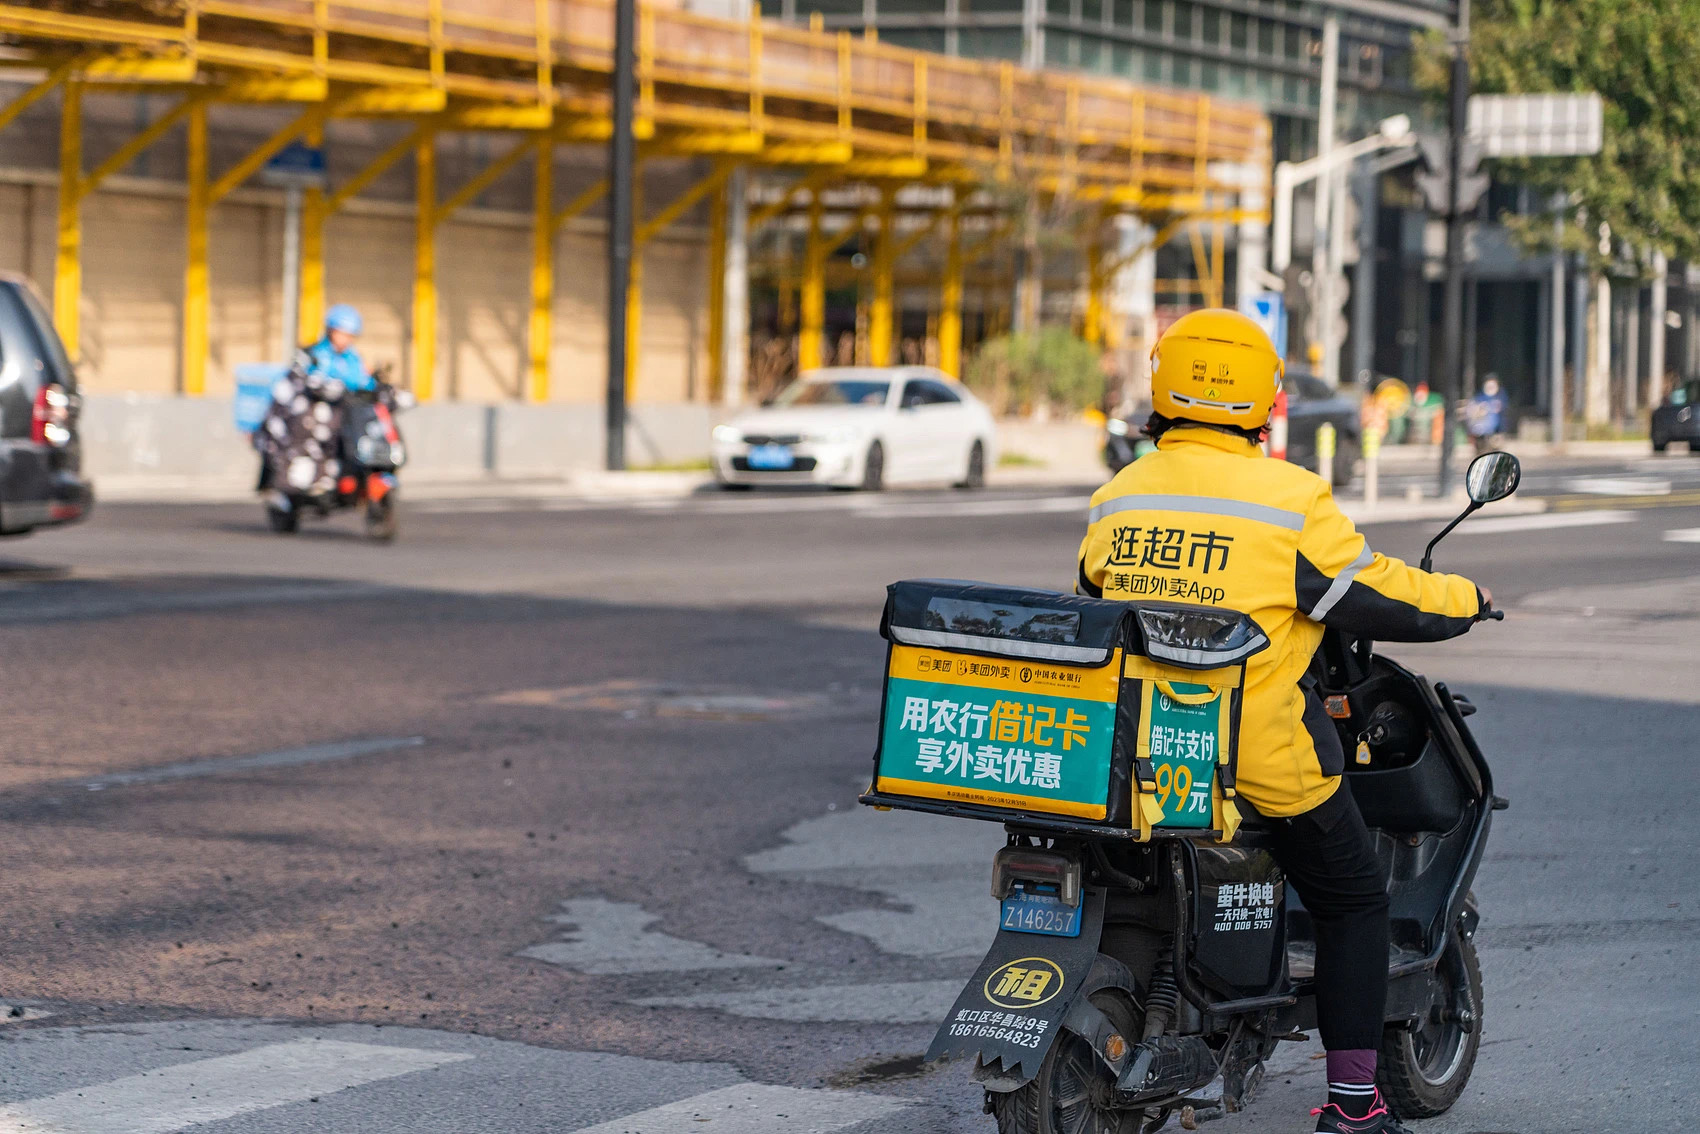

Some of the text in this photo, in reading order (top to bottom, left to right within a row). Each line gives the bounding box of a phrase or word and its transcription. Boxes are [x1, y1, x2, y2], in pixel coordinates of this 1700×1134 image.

[1104, 526, 1234, 574] 逛超市
[932, 659, 952, 672] 美团
[969, 662, 1011, 680] 美团外卖
[900, 696, 1090, 750] 用农行借记卡
[1150, 725, 1214, 761] 借记卡支付
[915, 738, 1063, 789] 享外卖优惠
[1217, 882, 1274, 908] 蛮牛换电
[1004, 906, 1074, 932] Z146257
[1214, 920, 1272, 932] 400 008 5757
[993, 967, 1053, 1000] 租
[955, 1008, 1049, 1034] 虹口区华昌路9号
[949, 1023, 1041, 1048] 18616564823
